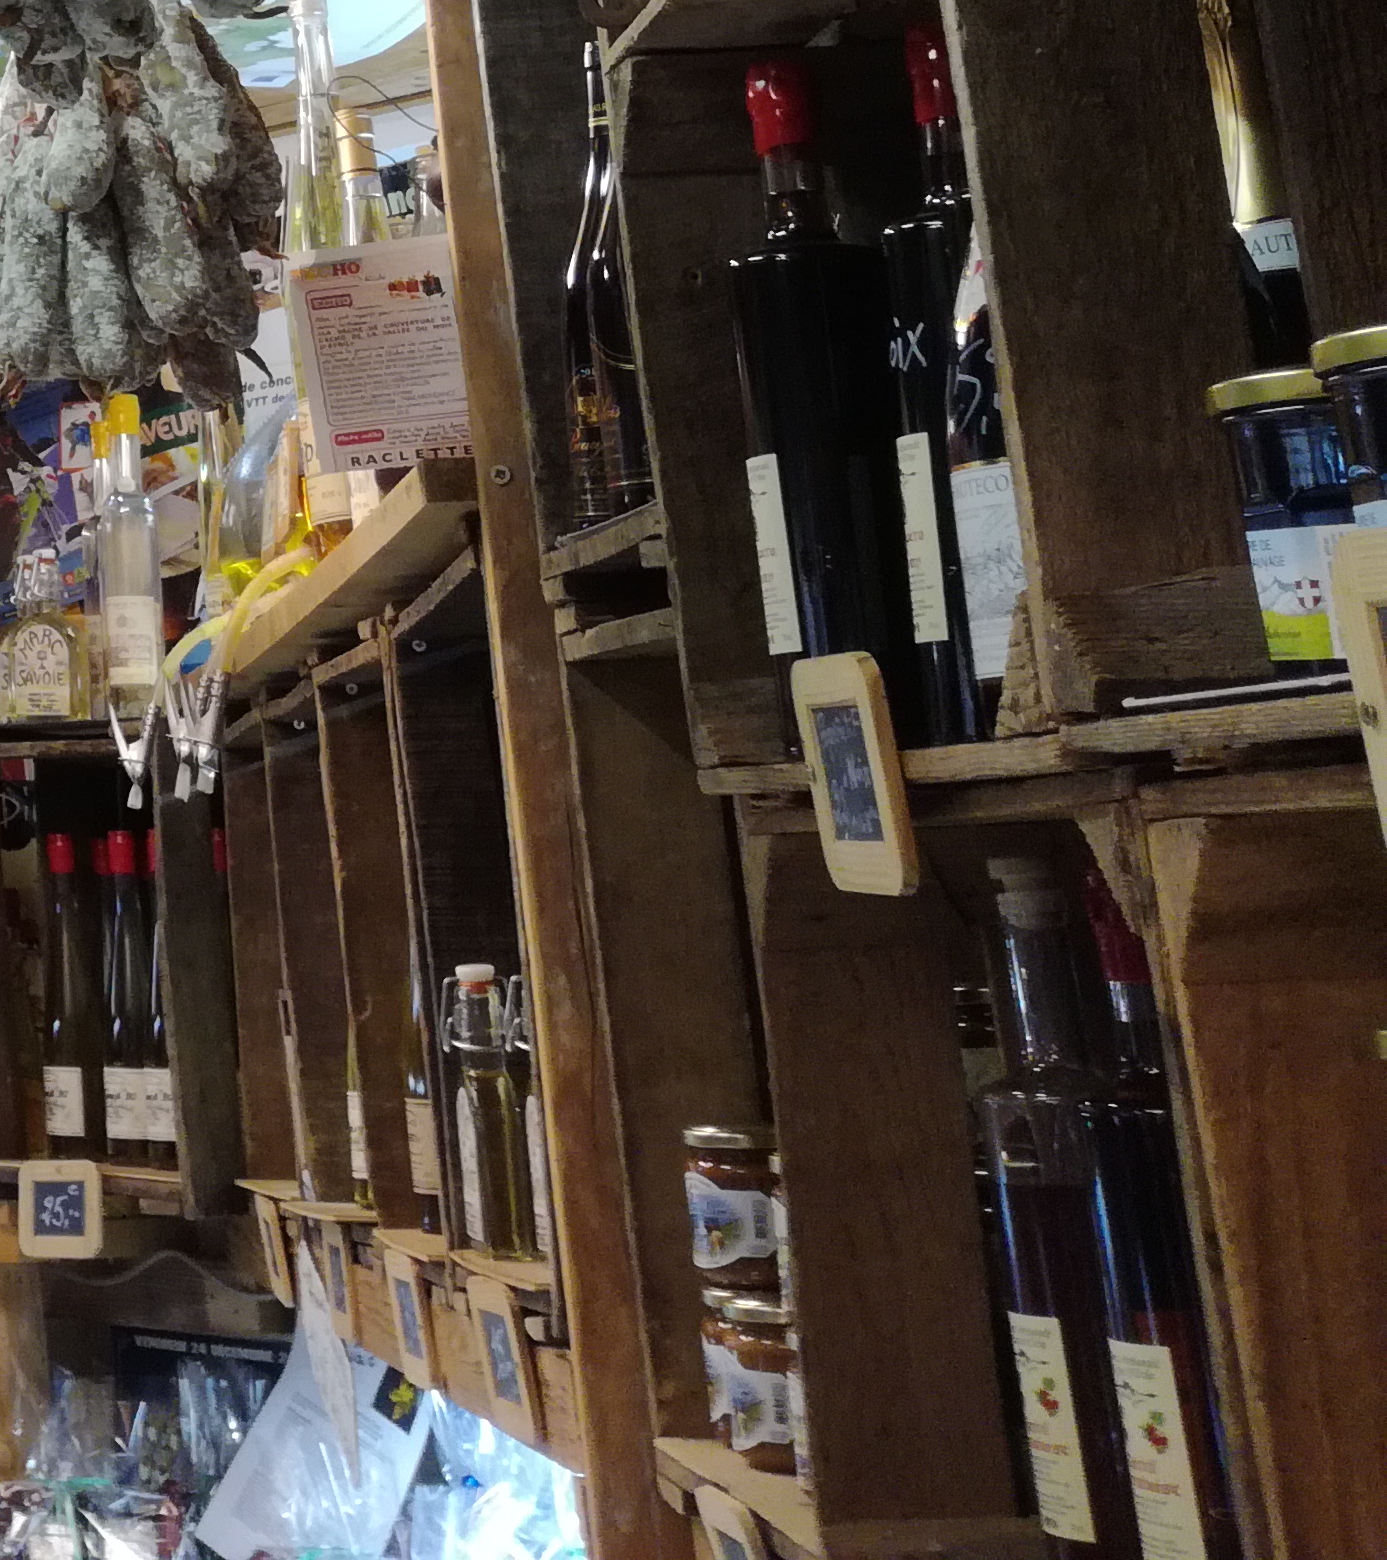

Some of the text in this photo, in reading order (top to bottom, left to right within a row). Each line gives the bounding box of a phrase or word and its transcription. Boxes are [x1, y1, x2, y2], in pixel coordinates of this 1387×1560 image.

[351, 444, 474, 467] RACLETTE
[19, 627, 64, 661] MARC
[17, 668, 66, 688] SAVOIE
